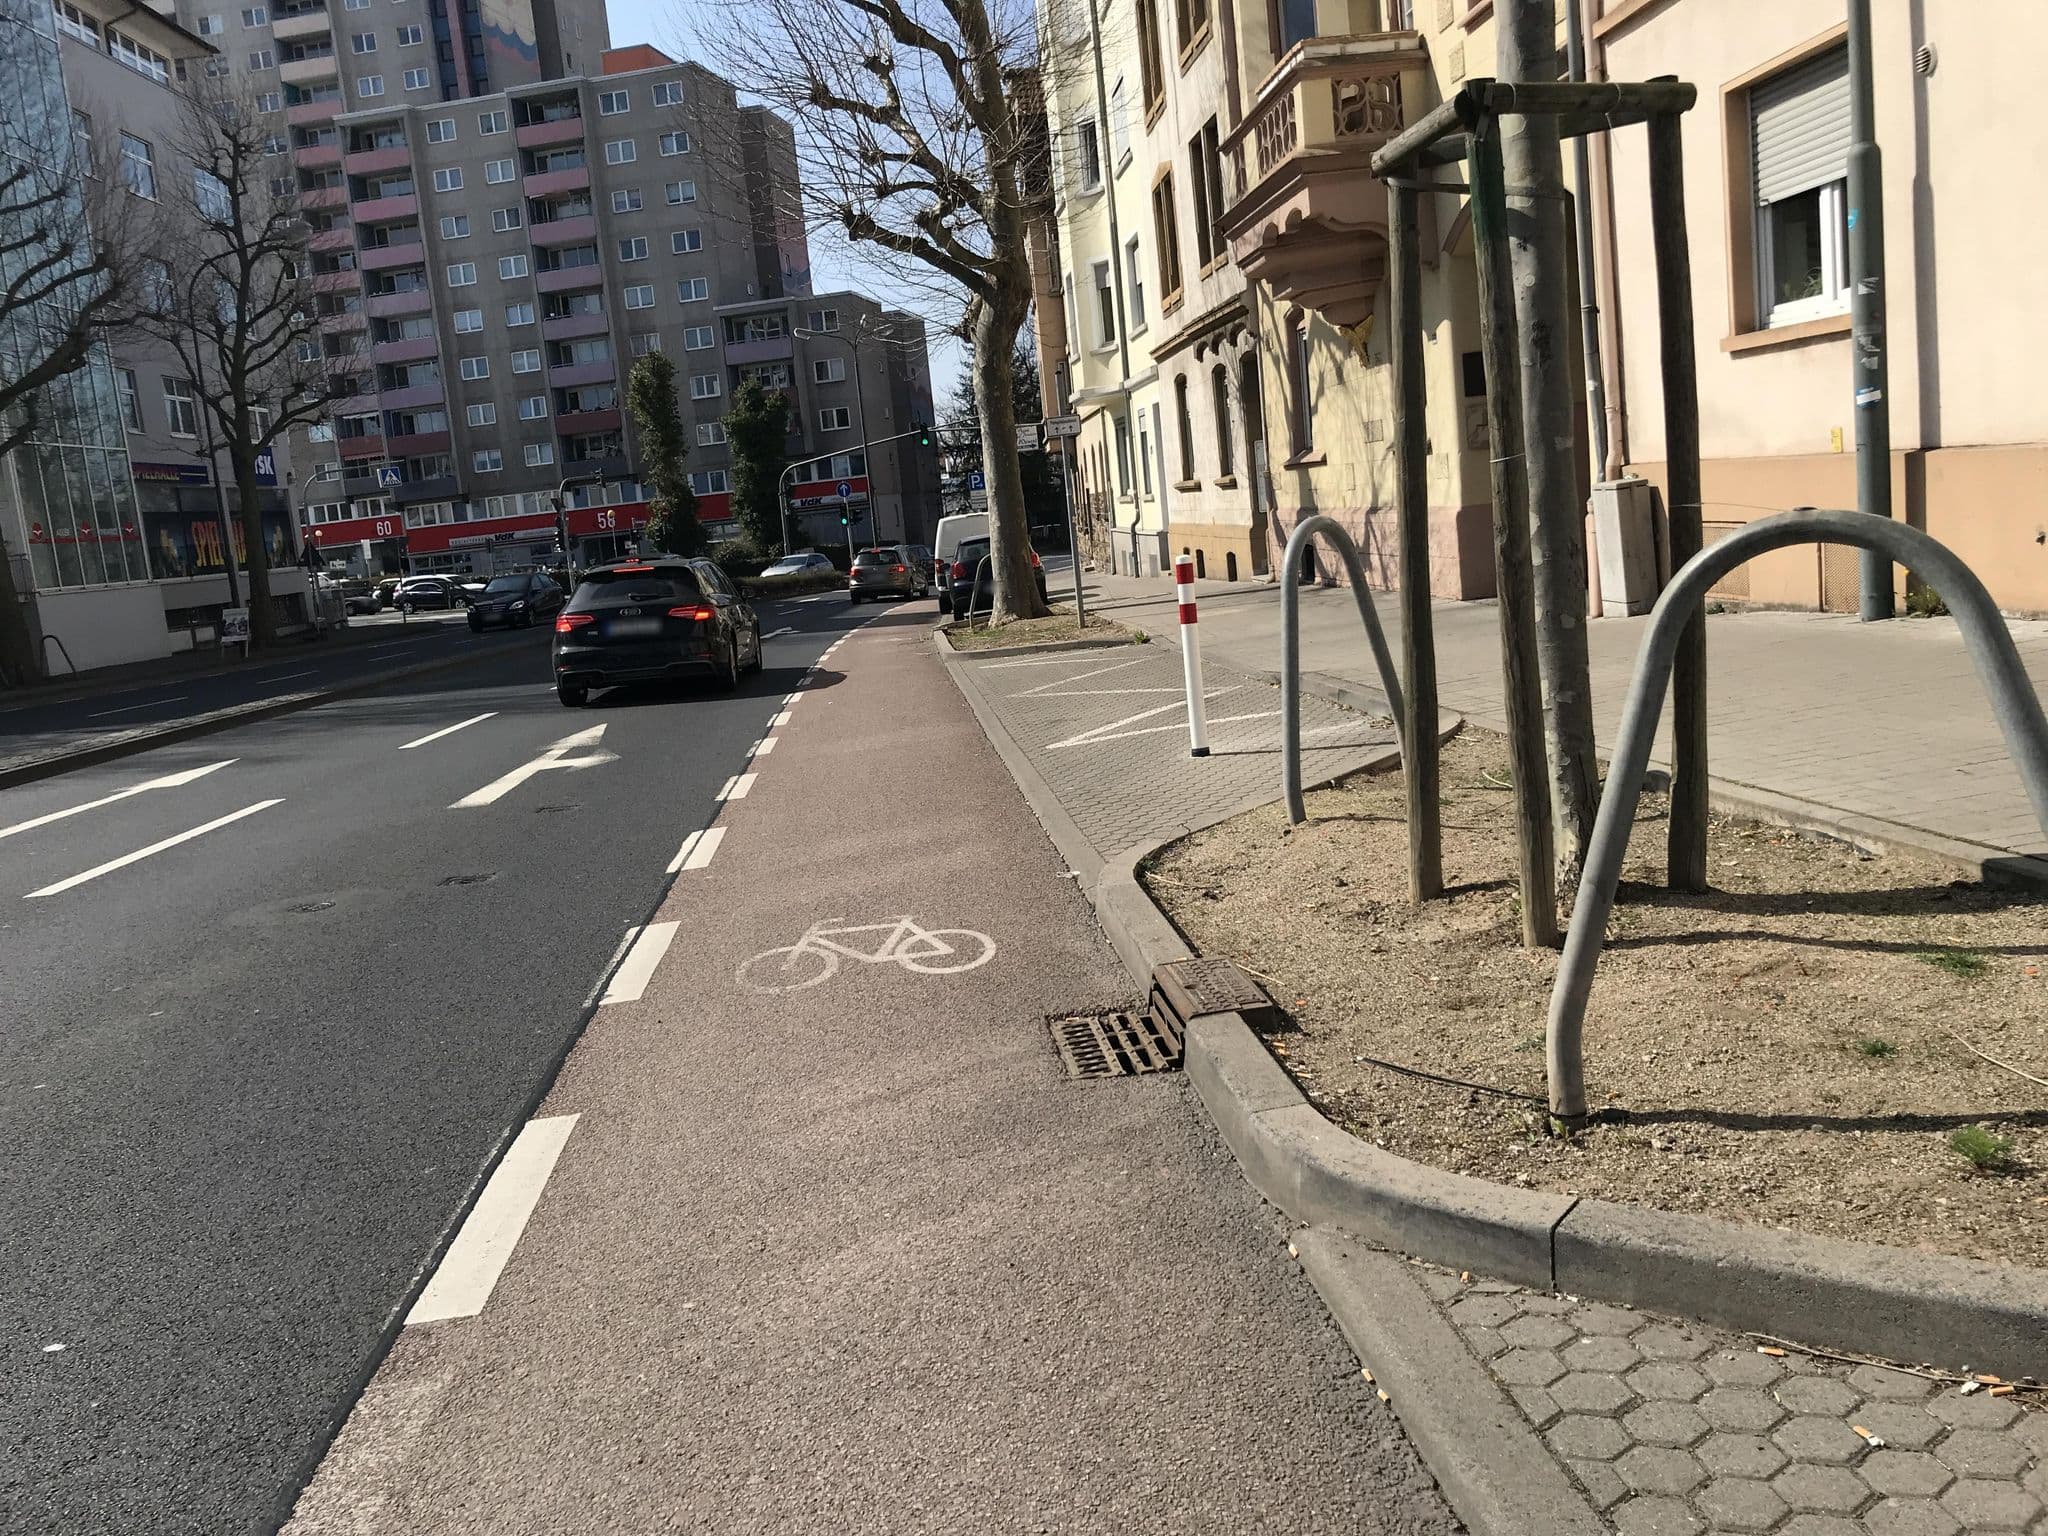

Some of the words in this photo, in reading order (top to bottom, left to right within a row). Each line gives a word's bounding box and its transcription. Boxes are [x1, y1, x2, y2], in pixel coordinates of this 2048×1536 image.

[970, 475, 981, 489] P
[376, 521, 392, 536] 60
[493, 532, 514, 542] VdK
